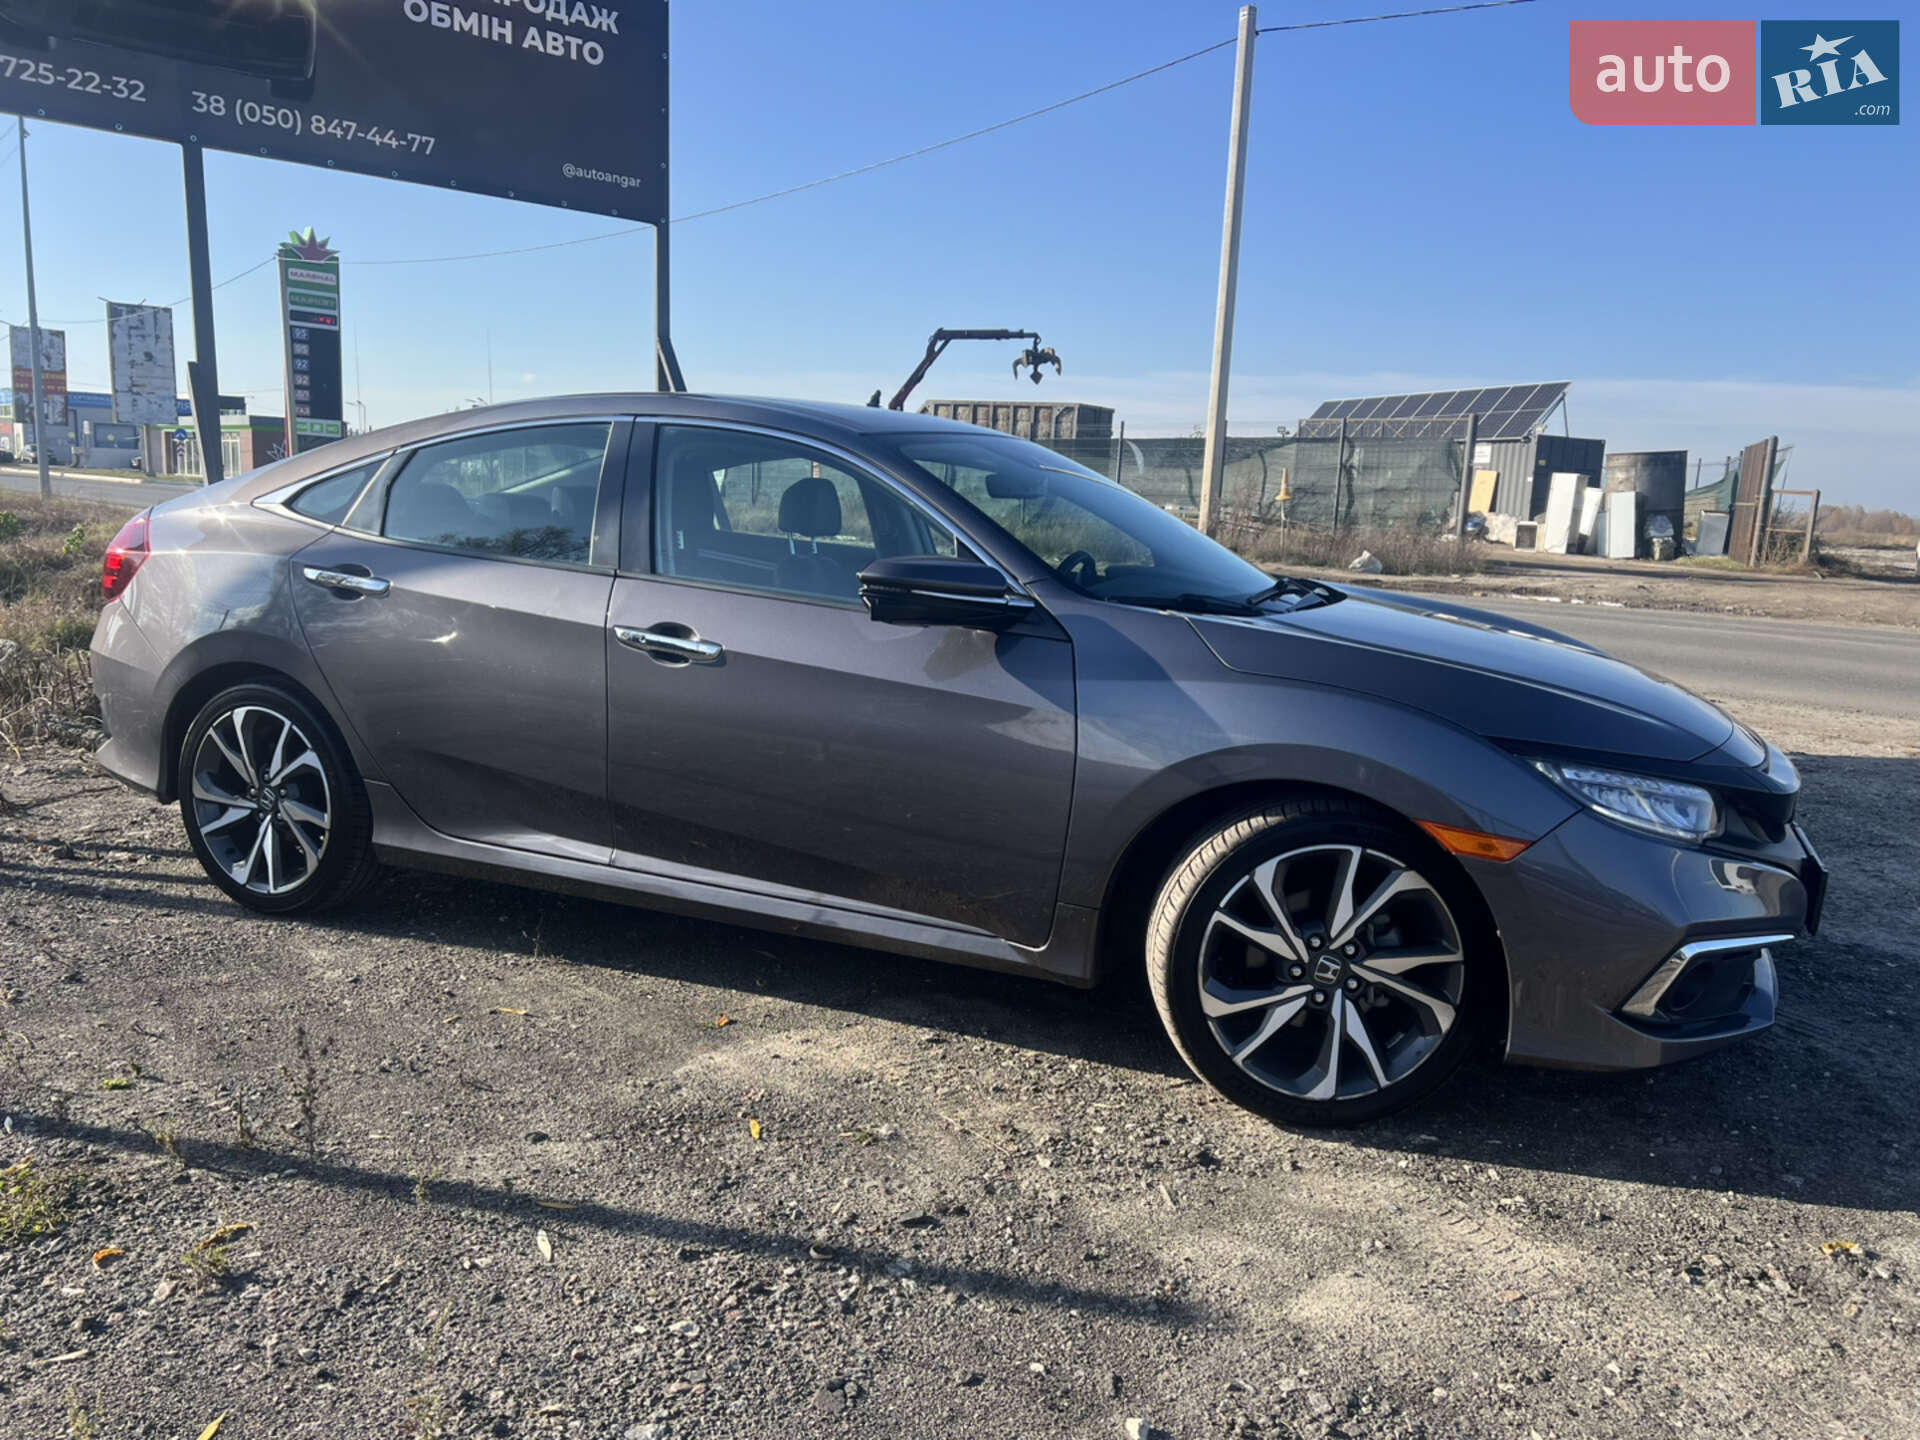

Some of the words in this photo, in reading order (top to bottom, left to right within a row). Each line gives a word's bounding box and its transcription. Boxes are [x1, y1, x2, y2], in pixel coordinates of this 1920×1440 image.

[403, 0, 513, 45] ОБМІН
[521, 26, 605, 66] АВТО
[493, 0, 619, 35] ОДАЖ
[0, 54, 147, 102] 725-22-32
[191, 91, 227, 116] 38
[235, 98, 302, 136] (050)
[310, 114, 436, 156] 847-44-77
[562, 163, 641, 188] @autoangar
